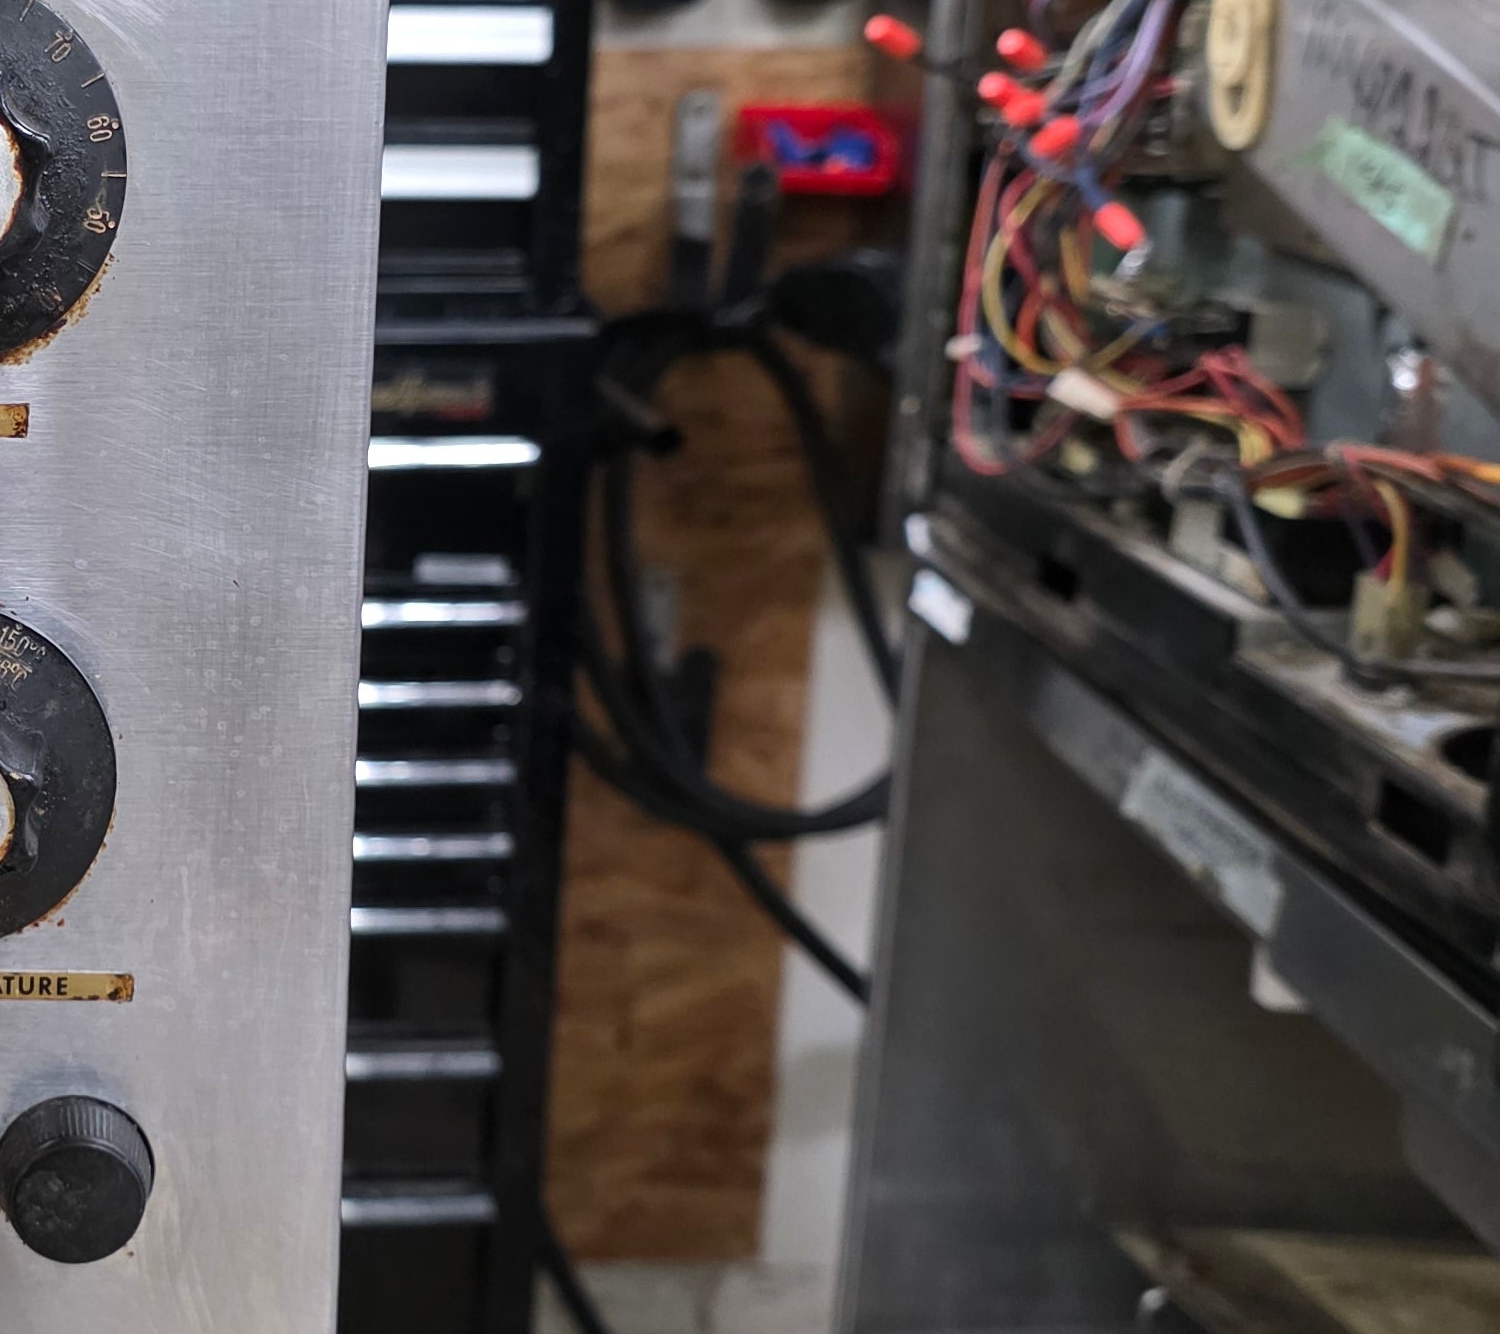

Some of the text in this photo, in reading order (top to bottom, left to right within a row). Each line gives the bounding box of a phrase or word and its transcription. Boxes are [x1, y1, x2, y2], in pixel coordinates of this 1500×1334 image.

[45, 31, 73, 63] 70
[86, 114, 113, 142] 60
[83, 207, 110, 234] 50
